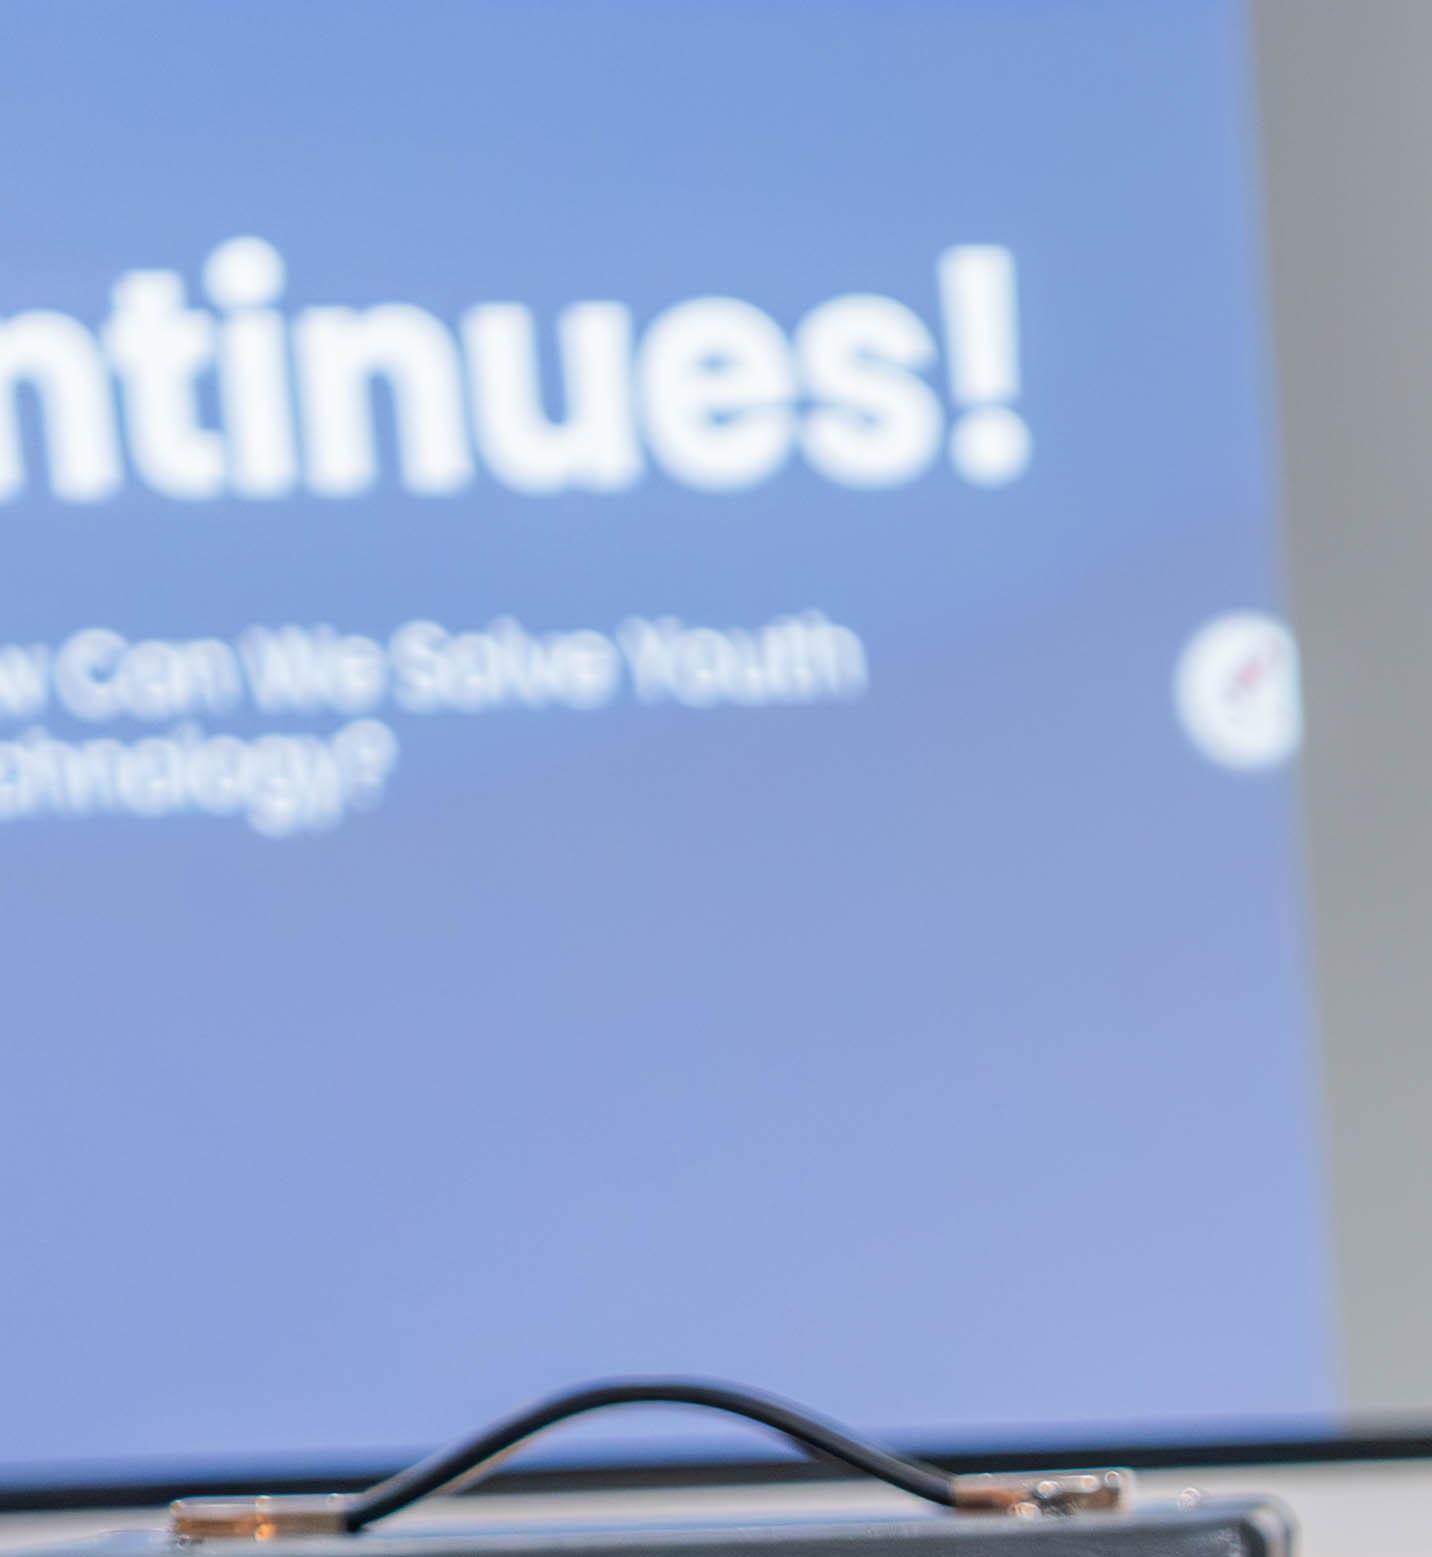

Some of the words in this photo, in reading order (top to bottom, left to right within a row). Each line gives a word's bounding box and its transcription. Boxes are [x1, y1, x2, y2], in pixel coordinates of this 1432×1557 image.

[0, 235, 1032, 505] ntinues!
[55, 626, 243, 722] Can
[238, 622, 387, 715] We
[389, 615, 619, 714] Solve
[618, 606, 870, 708] Youth
